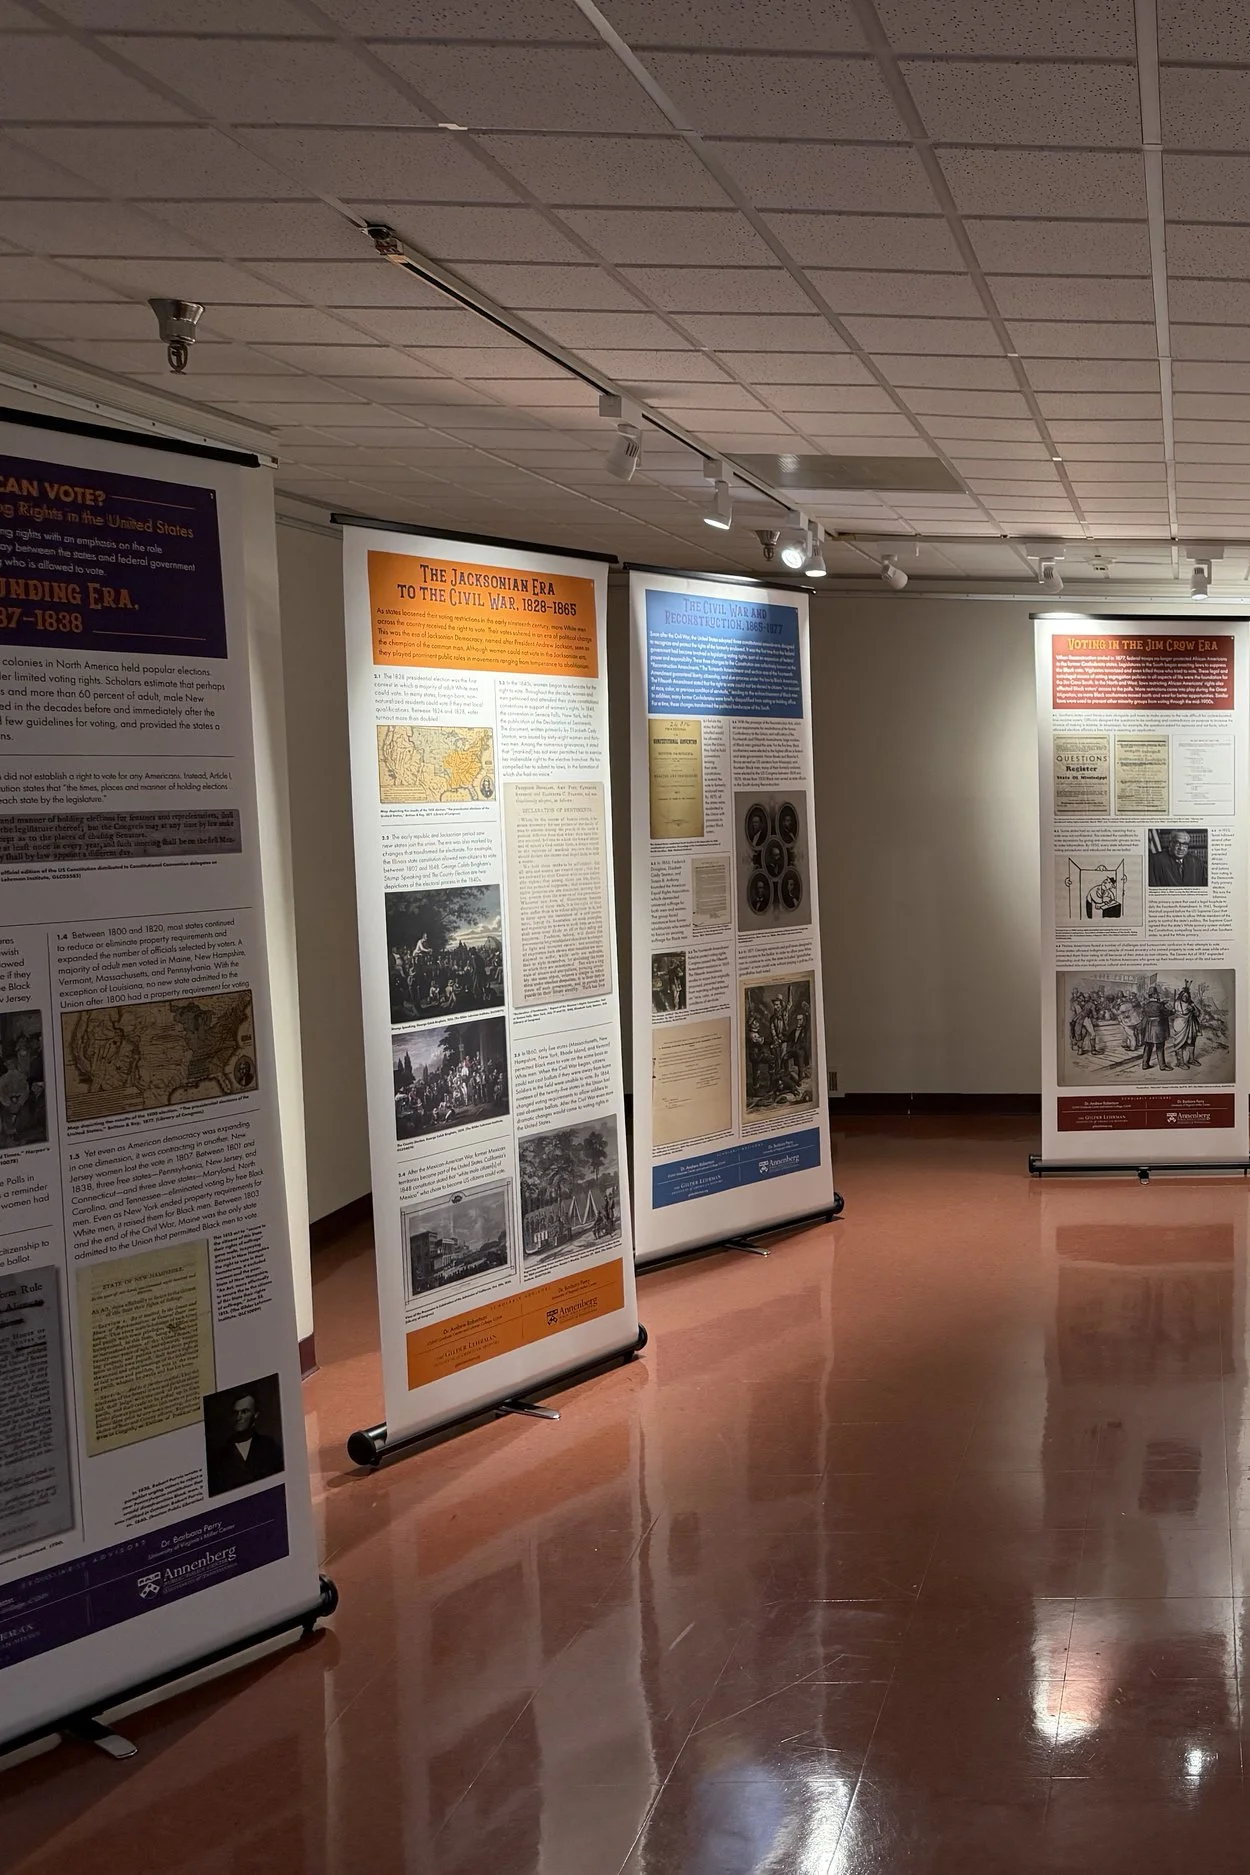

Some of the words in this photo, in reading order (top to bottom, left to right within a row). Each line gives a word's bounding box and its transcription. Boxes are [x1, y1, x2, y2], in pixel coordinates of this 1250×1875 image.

[44, 481, 106, 507] VOTE?
[18, 501, 63, 521] Rights
[67, 511, 79, 523] in
[81, 510, 105, 526] the
[106, 514, 153, 532] United
[156, 520, 194, 538] States
[420, 564, 447, 583] THE
[449, 568, 529, 594] JACKSONIAN
[531, 577, 556, 596] ERA
[397, 583, 415, 599] TO
[419, 584, 446, 603] THE
[449, 583, 485, 607] CIVIL
[487, 592, 520, 611] WAR,
[683, 598, 701, 613] THE
[703, 601, 727, 616] CIVIL
[729, 604, 749, 618] WAR
[750, 608, 767, 619] AND
[1067, 638, 1106, 651] VOTING
[1107, 640, 1120, 651] IN
[1122, 640, 1144, 650] THE
[1145, 639, 1165, 652] JIM
[1166, 639, 1197, 652] CROW
[1198, 639, 1218, 652] ERA
[2, 656, 43, 668] colonies
[45, 659, 53, 667] in
[56, 659, 81, 669] North
[83, 661, 119, 671] America
[121, 662, 140, 672] held
[142, 664, 175, 675] popular
[177, 665, 211, 676] elections.
[1056, 755, 1108, 763] QUESTIONS
[1065, 765, 1098, 773] Register
[71, 931, 105, 939] Between
[108, 927, 127, 936] 1800
[128, 925, 143, 935] and
[166, 922, 183, 931] most
[185, 920, 203, 930] states
[204, 918, 235, 929] continued
[1177, 1112, 1211, 1120] Annenberg
[768, 1154, 800, 1169] Annenberg
[164, 1544, 237, 1582] Annenberg
